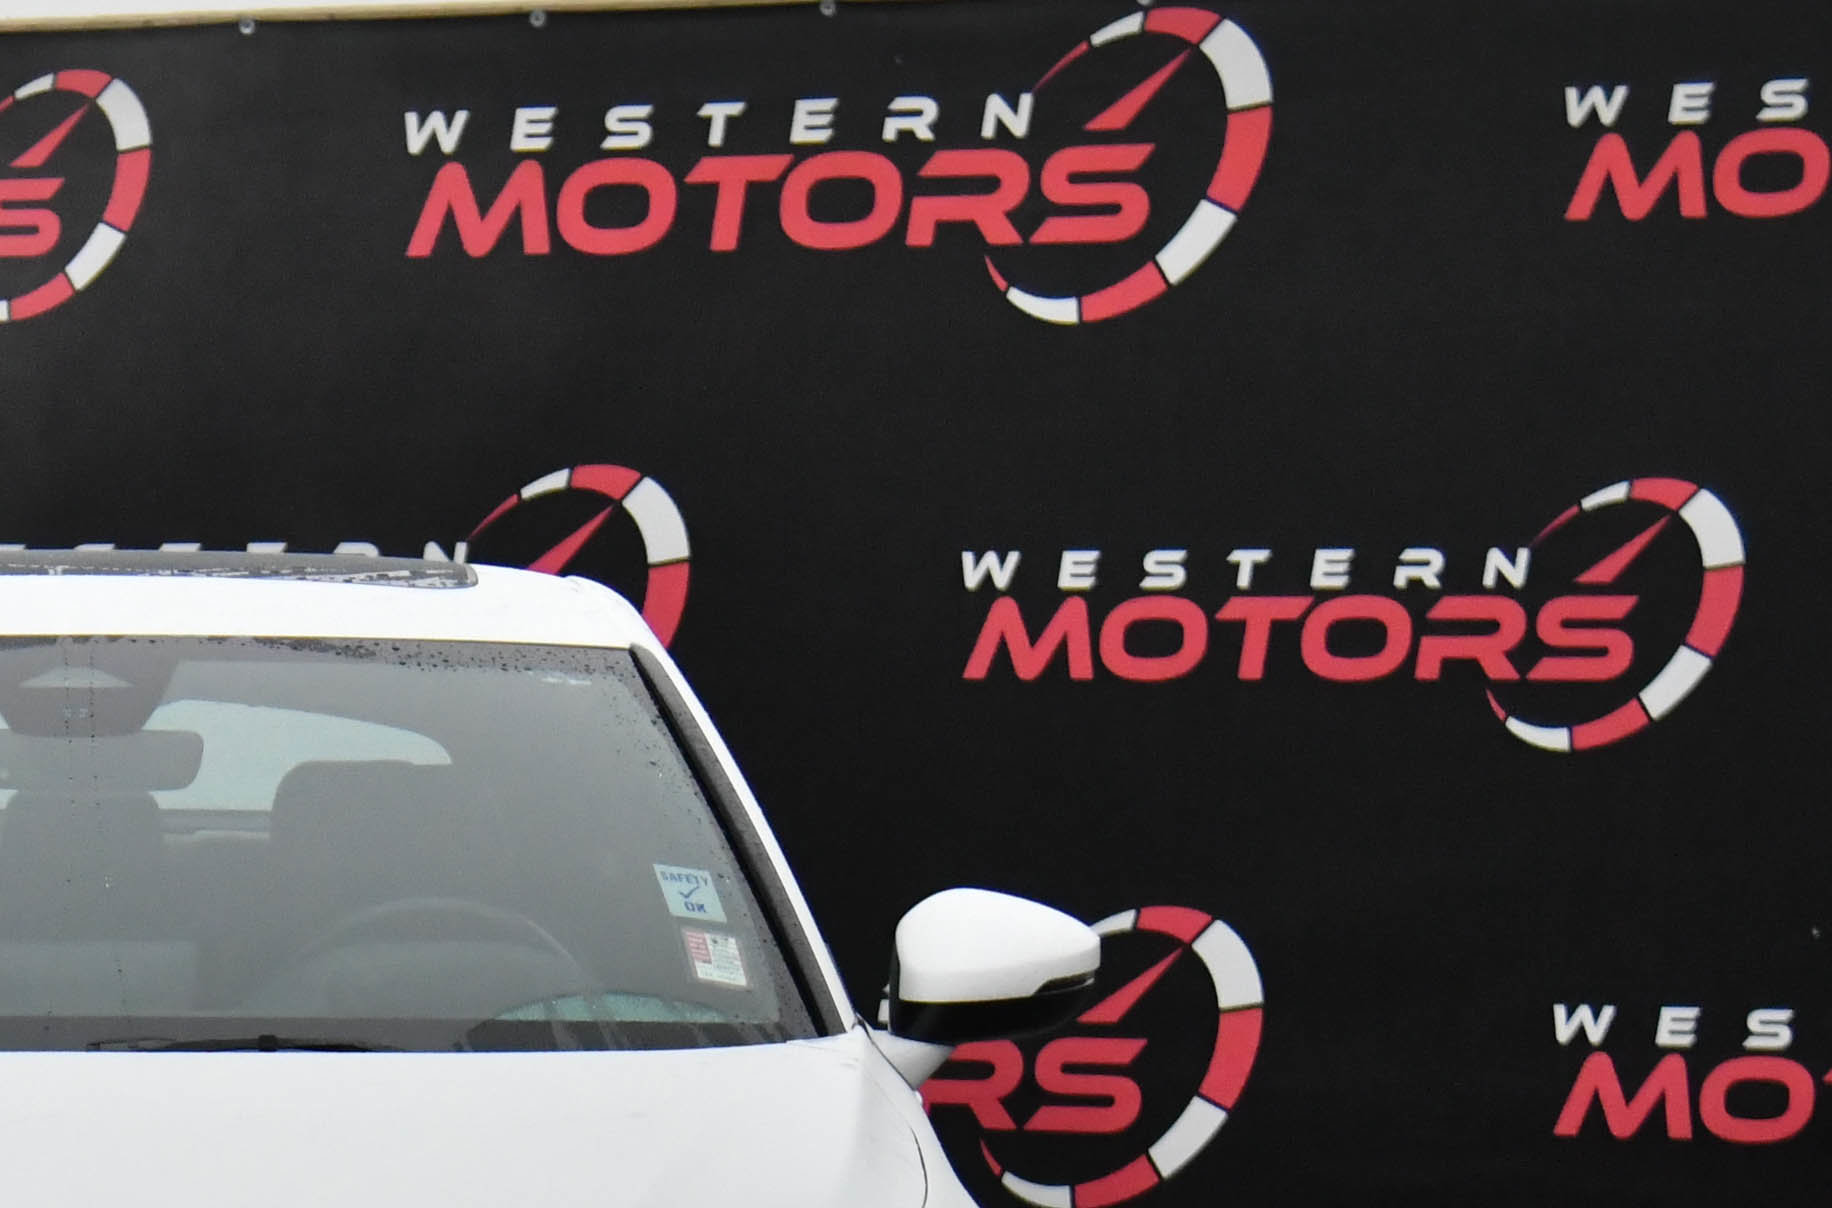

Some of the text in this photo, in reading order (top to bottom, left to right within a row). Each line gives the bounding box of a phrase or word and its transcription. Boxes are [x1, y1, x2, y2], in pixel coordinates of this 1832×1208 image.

[404, 92, 1034, 155] WESTERN
[1565, 78, 1809, 127] WES
[406, 143, 1156, 259] MOTORS
[1564, 127, 1832, 221] MO
[961, 547, 1530, 590] WESTERN
[963, 595, 1639, 683] MOTORS
[659, 870, 709, 886] SAFETY
[683, 900, 708, 914] OK
[1553, 1003, 1794, 1050] WES
[1553, 1051, 1832, 1145] MO
